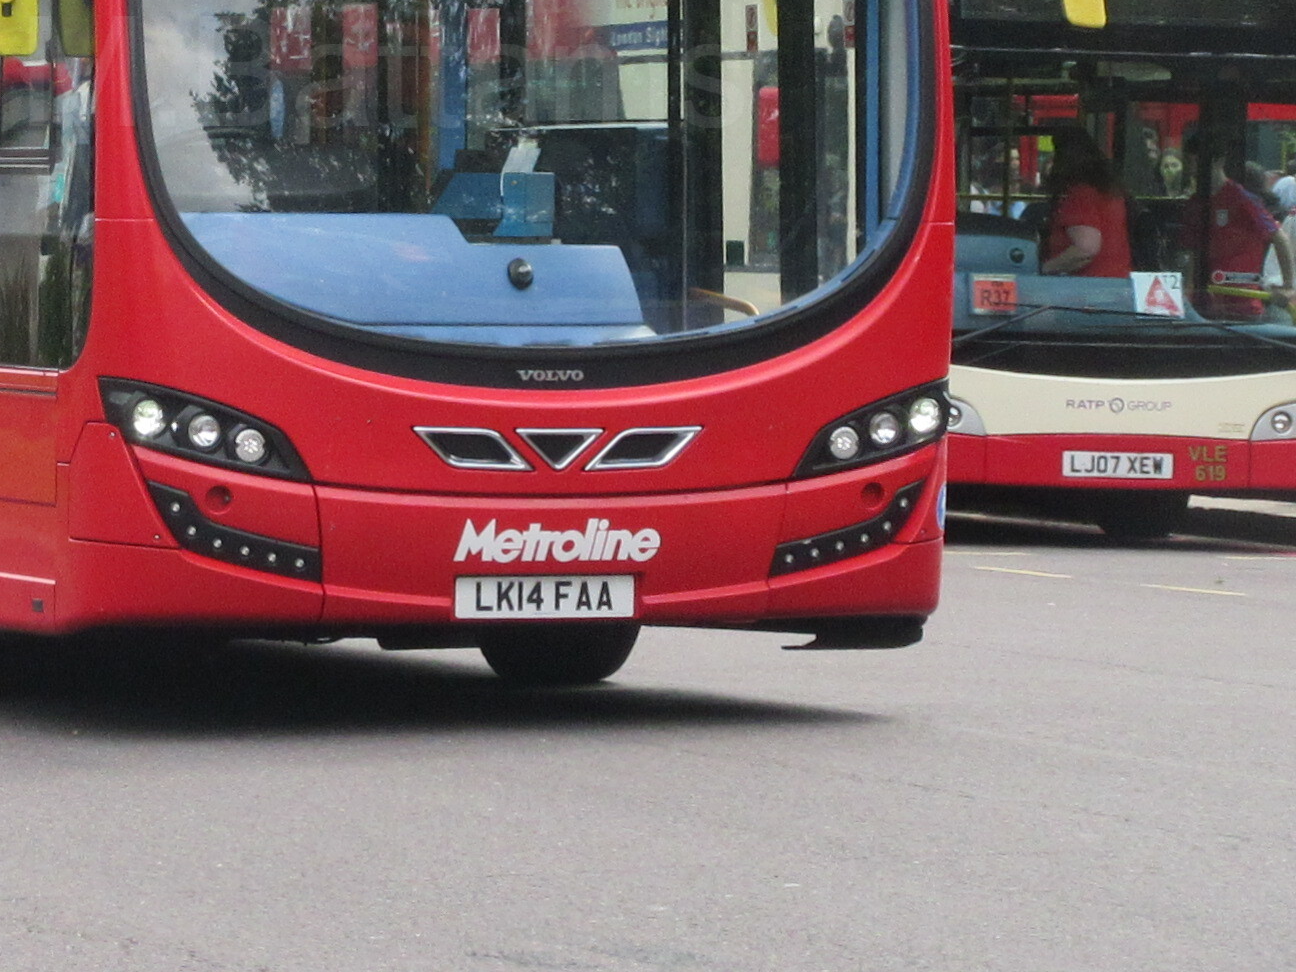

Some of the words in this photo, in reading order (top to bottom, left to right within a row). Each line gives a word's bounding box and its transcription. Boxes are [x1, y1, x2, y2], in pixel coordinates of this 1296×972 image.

[517, 369, 584, 381] VOLVO
[1066, 399, 1105, 410] RATP
[1127, 400, 1173, 412] GROUP
[1189, 445, 1228, 463] VLE
[1070, 454, 1121, 474] LJ07
[1195, 465, 1226, 482] 619
[453, 518, 661, 563] Metroline
[475, 581, 544, 612] LK14
[555, 581, 613, 612] FAA
